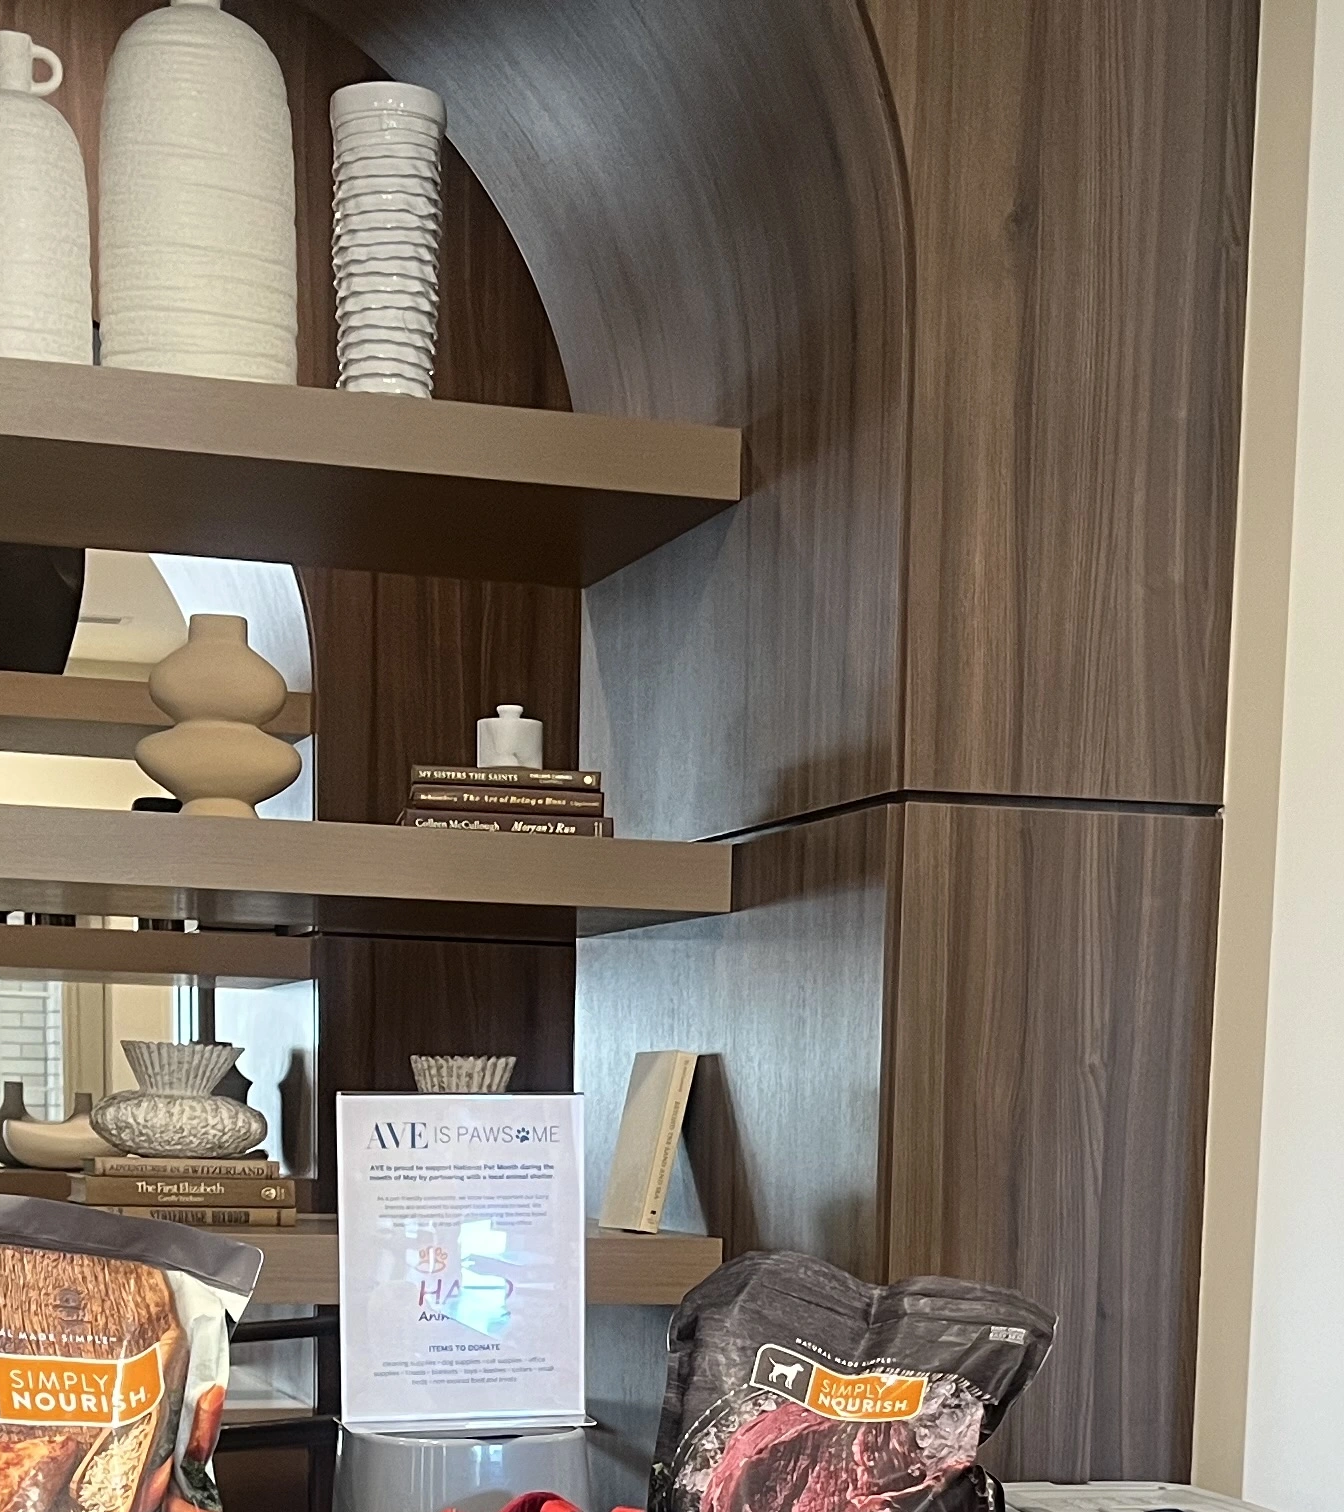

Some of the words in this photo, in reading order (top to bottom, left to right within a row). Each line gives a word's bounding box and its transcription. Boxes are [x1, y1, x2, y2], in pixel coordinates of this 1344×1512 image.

[433, 771, 467, 780] SISTERS
[469, 772, 486, 780] THE
[488, 773, 518, 782] SAINTS
[415, 818, 447, 829] Colleen
[556, 822, 576, 834] Run
[366, 1122, 428, 1149] AVE
[434, 1126, 451, 1143] IS
[108, 1164, 167, 1173] ADVENTURES
[183, 1165, 265, 1177] SWITZERLAND
[136, 1181, 156, 1193] The
[157, 1182, 178, 1193] First
[179, 1182, 224, 1194] Elizabeth
[19, 1332, 55, 1341] MADE
[428, 1344, 453, 1352] ITEMS
[456, 1344, 466, 1352] TO
[468, 1344, 500, 1352] DONATE
[795, 1337, 831, 1360] NATURAL
[10, 1369, 108, 1393] SIMPLY
[821, 1379, 885, 1399] SIMPLY
[12, 1386, 147, 1413] NOURISH
[818, 1393, 908, 1413] NOURISH
